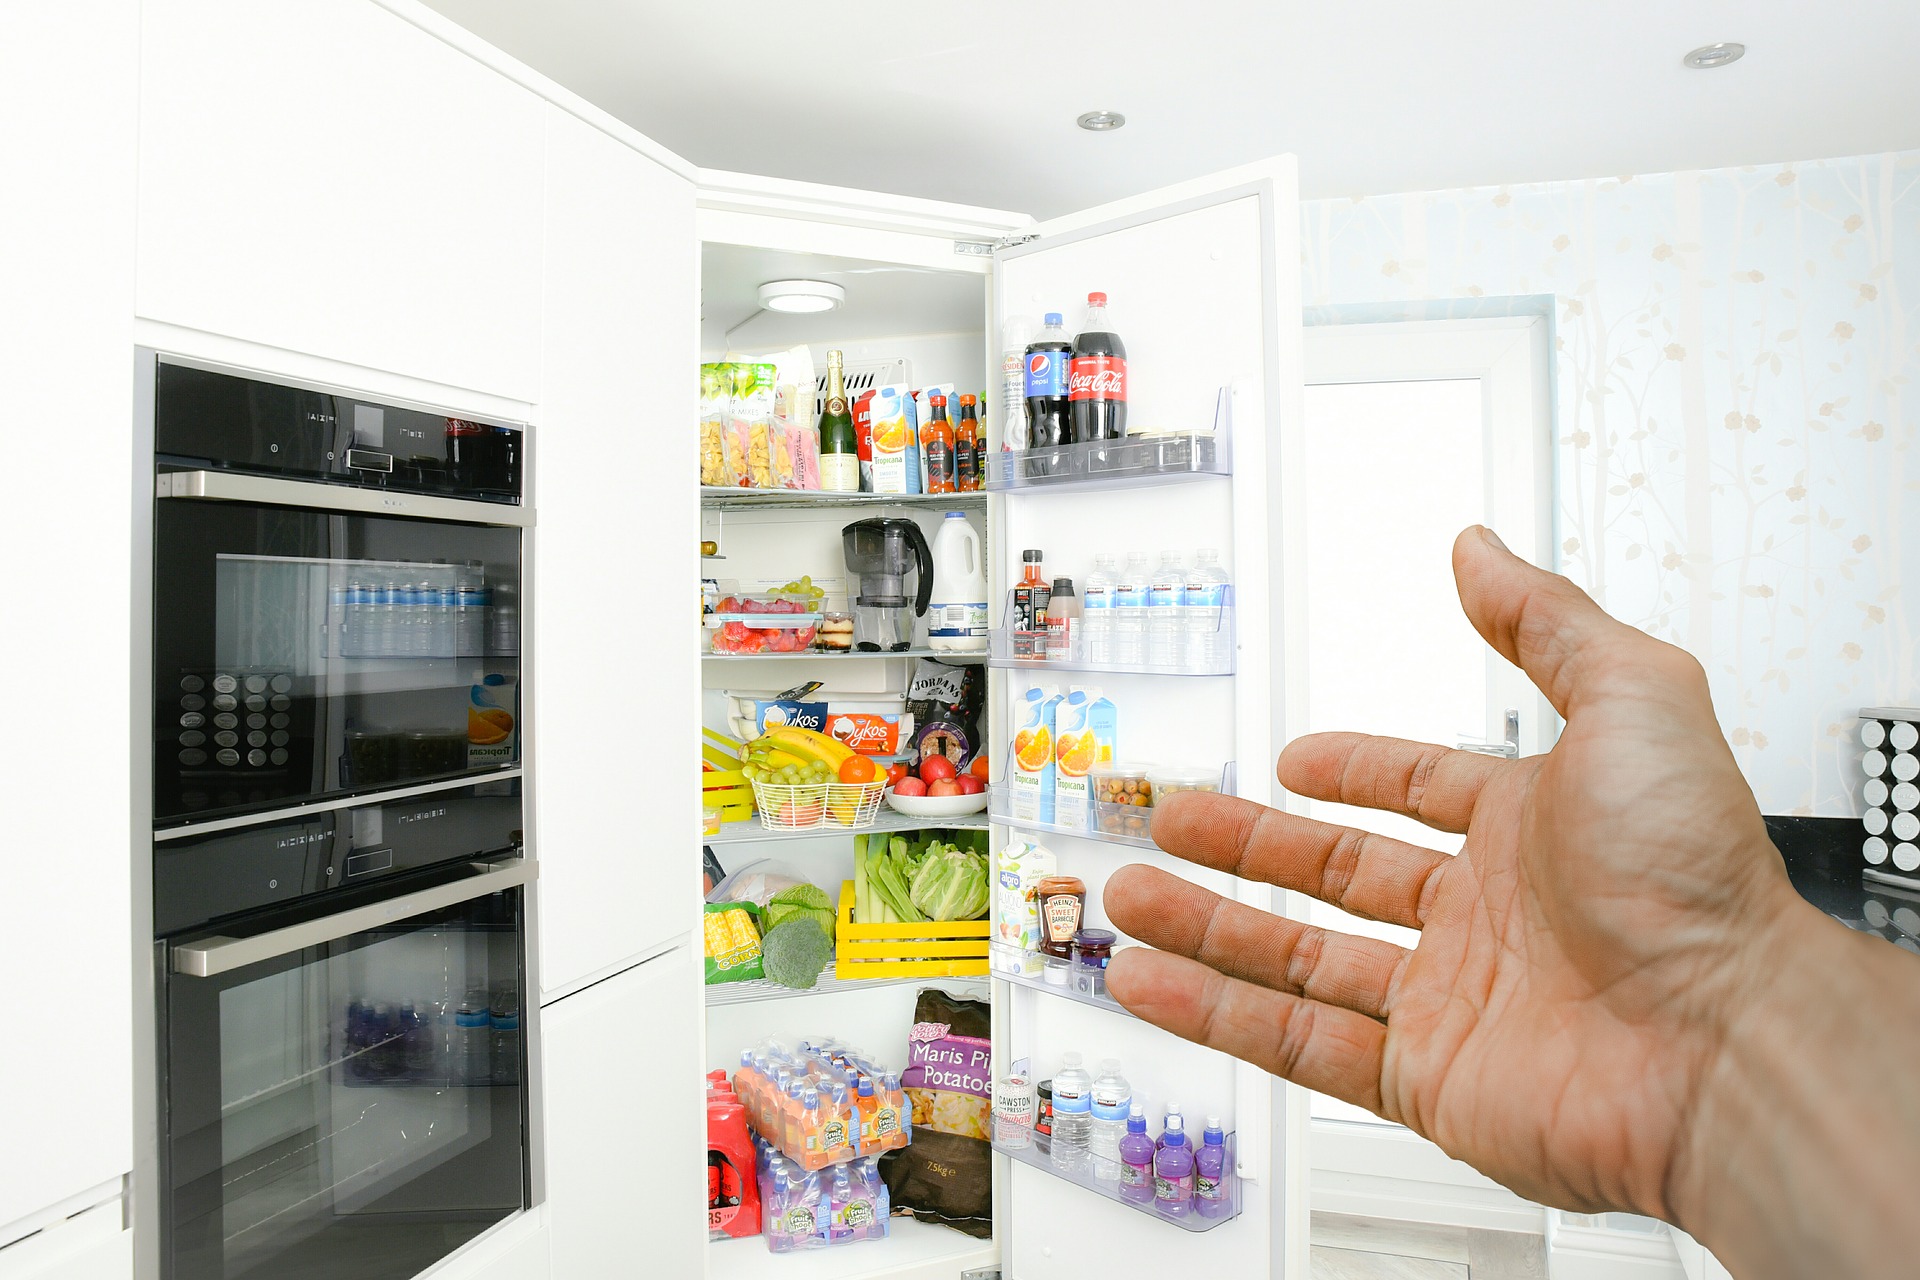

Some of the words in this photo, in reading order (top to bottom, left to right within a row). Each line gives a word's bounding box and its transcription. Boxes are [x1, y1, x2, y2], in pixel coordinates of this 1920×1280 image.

[1032, 378, 1049, 386] pepsi
[1070, 370, 1123, 394] Coca-Cola
[874, 457, 903, 465] Tropicana
[915, 677, 961, 699] JORDANS
[832, 716, 888, 746] Oykos
[1014, 772, 1039, 786] Tropicana
[1056, 777, 1085, 791] Tropicana
[1001, 873, 1019, 886] alpro
[1053, 899, 1073, 907] HEINZ
[1051, 908, 1075, 916] SWEET
[1052, 915, 1075, 924] BARBECUE
[719, 946, 762, 970] CORN
[914, 1043, 964, 1065] Maris
[924, 1065, 992, 1095] Potatoe
[998, 1095, 1031, 1107] CAWSTON
[926, 1161, 948, 1178] 7.5kg
[850, 1206, 868, 1216] Fruit
[791, 1214, 809, 1225] Fruit
